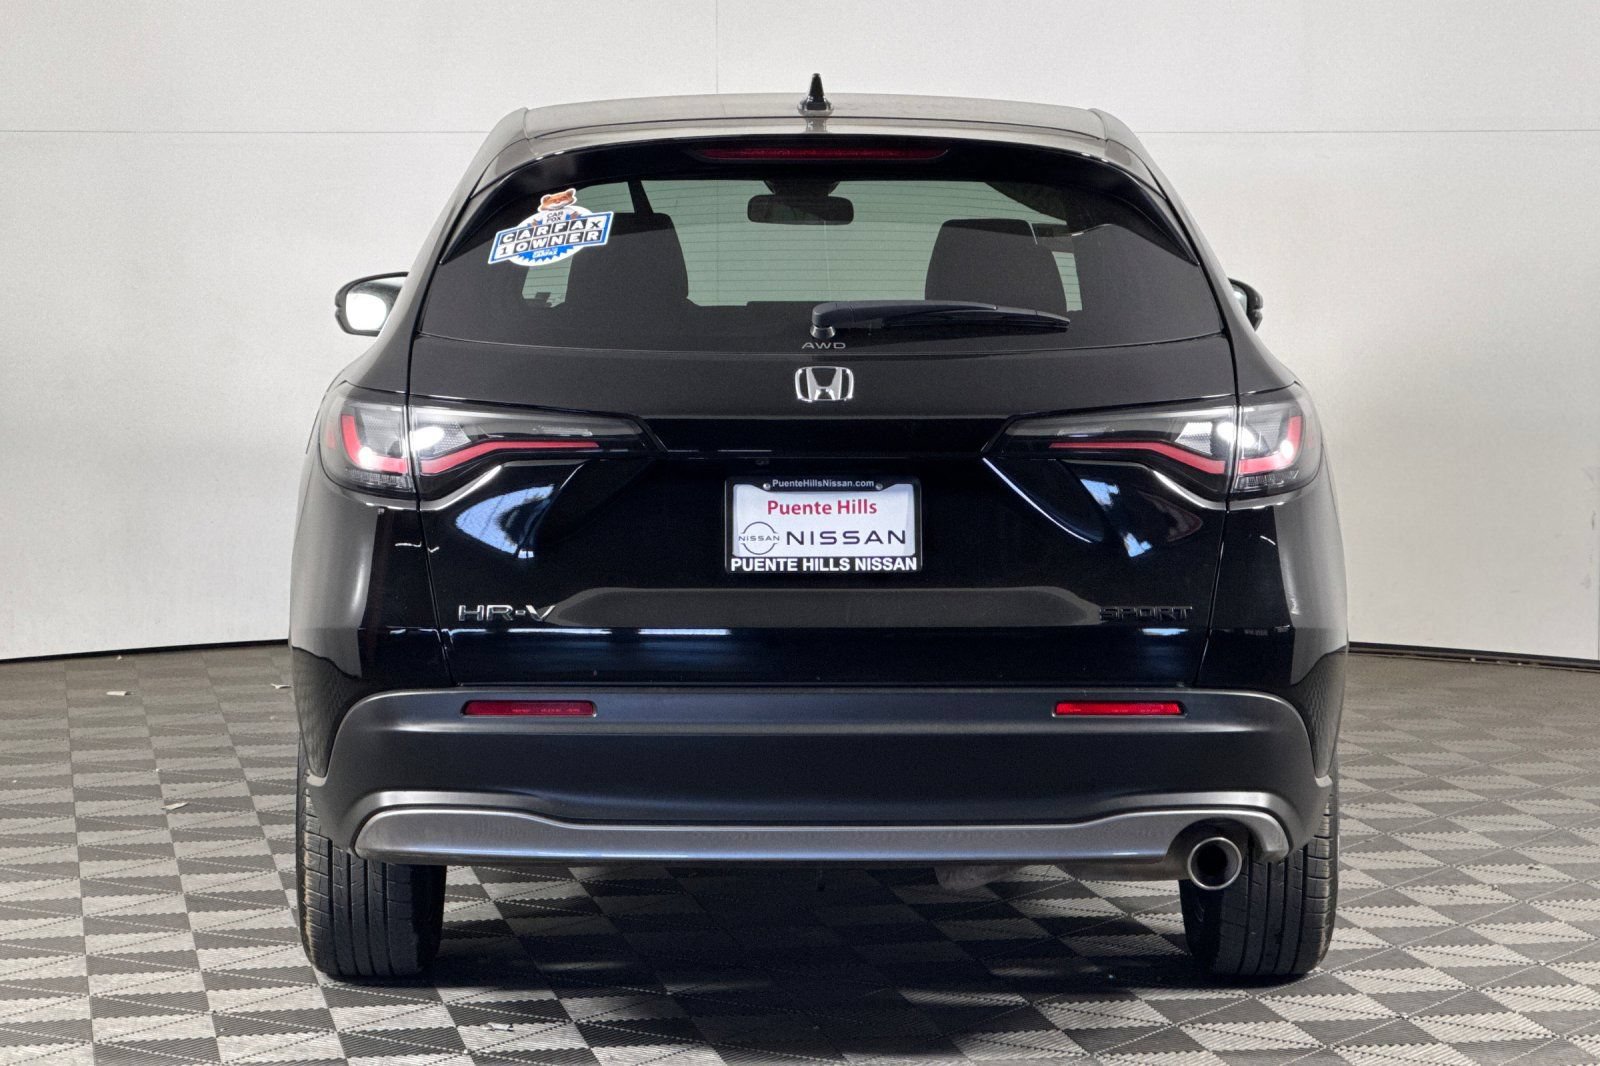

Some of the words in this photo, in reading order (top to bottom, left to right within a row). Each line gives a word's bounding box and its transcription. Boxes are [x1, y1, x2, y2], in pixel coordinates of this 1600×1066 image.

[502, 220, 602, 243] CARFAX
[500, 245, 509, 255] 1
[515, 231, 599, 252] OWNER
[772, 479, 875, 488] PuenteHillsNissan.com
[767, 500, 832, 515] Puente
[837, 499, 878, 514] Hills
[786, 530, 906, 545] NISSAN
[731, 558, 798, 571] PUENTE
[802, 558, 850, 571] HILLS
[855, 557, 917, 571] NISSAN
[458, 604, 556, 621] HR-V
[1099, 605, 1193, 622] SPORT
